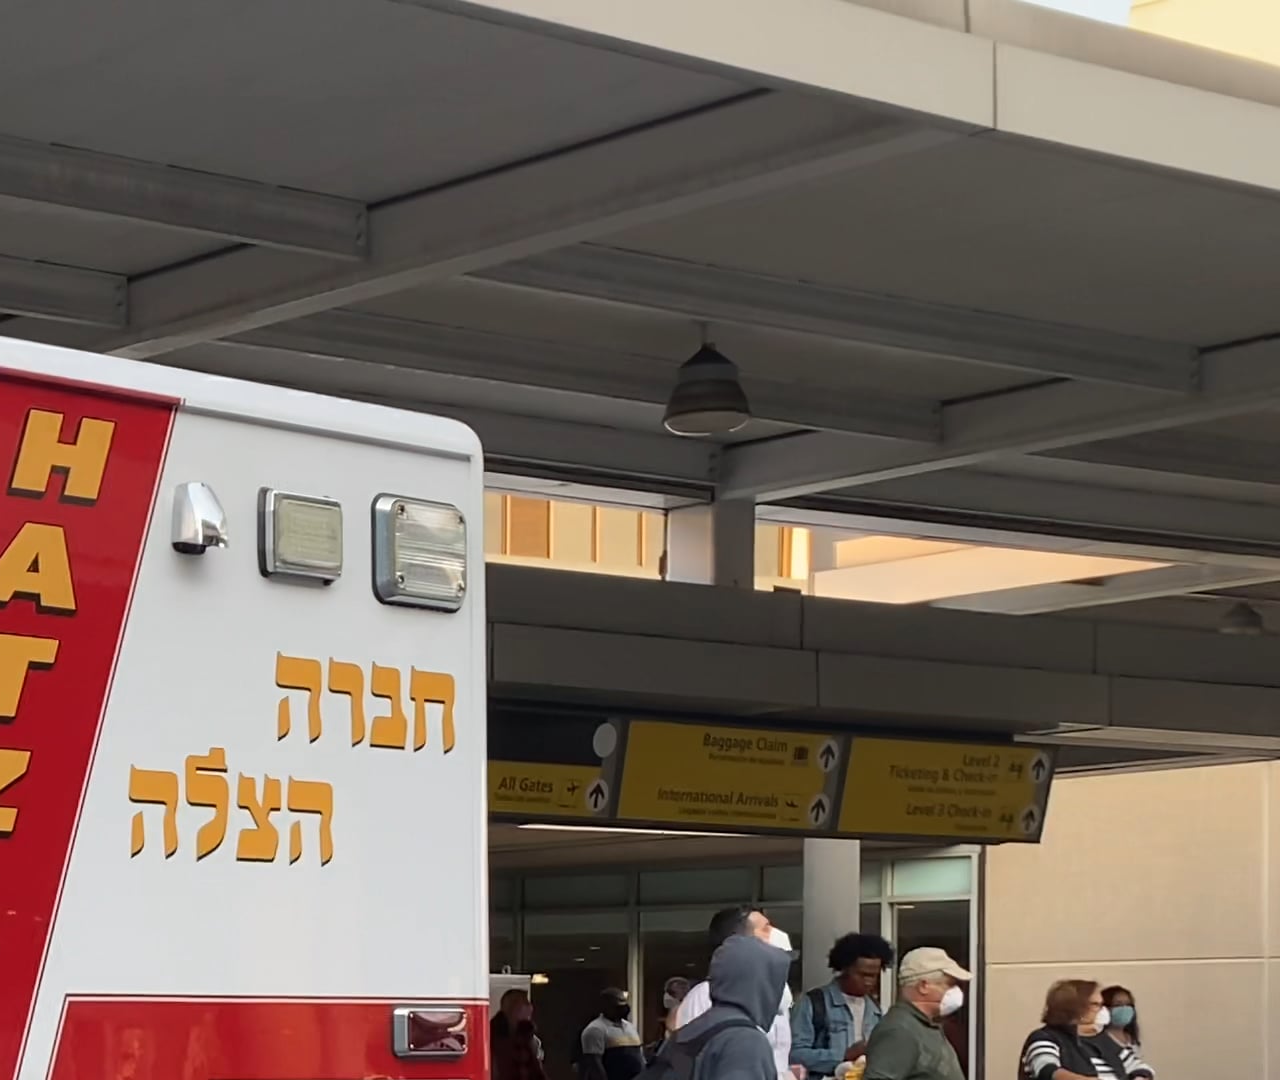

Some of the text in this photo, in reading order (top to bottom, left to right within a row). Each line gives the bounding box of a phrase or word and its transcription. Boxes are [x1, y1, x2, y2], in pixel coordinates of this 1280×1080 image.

[275, 650, 456, 755] חברה
[703, 732, 788, 752] Baggage Claim
[498, 776, 554, 793] All Gates
[657, 787, 779, 808] International Arrivals
